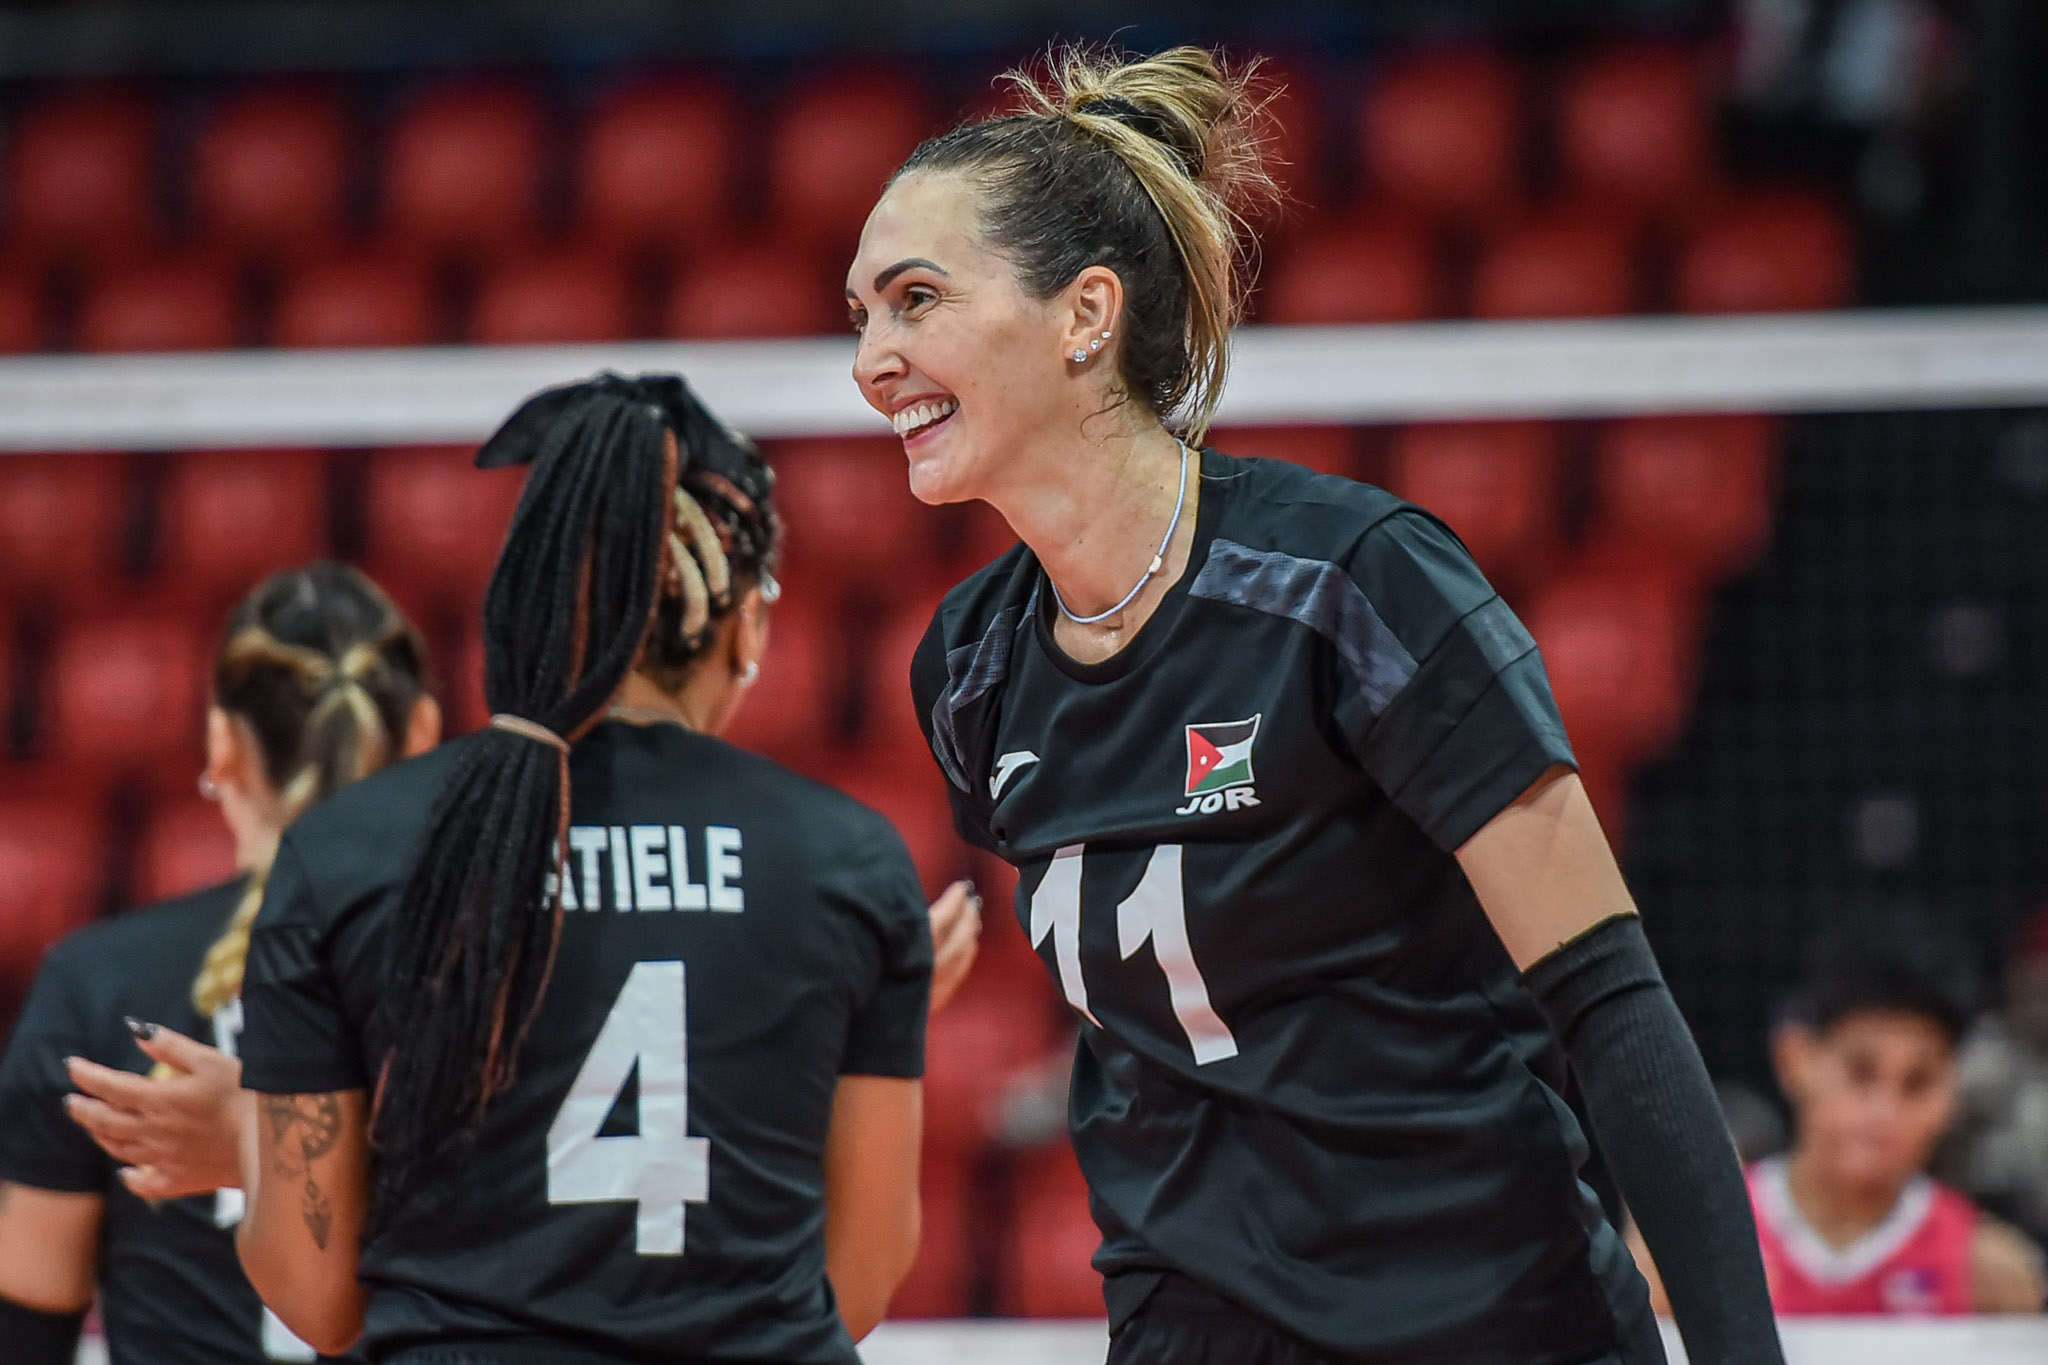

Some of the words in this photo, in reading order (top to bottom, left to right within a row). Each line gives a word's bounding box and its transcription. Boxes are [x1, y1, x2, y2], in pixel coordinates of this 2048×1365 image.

[542, 825, 745, 913] ATIELE
[1175, 787, 1262, 816] JOR
[1030, 843, 1239, 1066] 11
[547, 960, 710, 1257] 4
